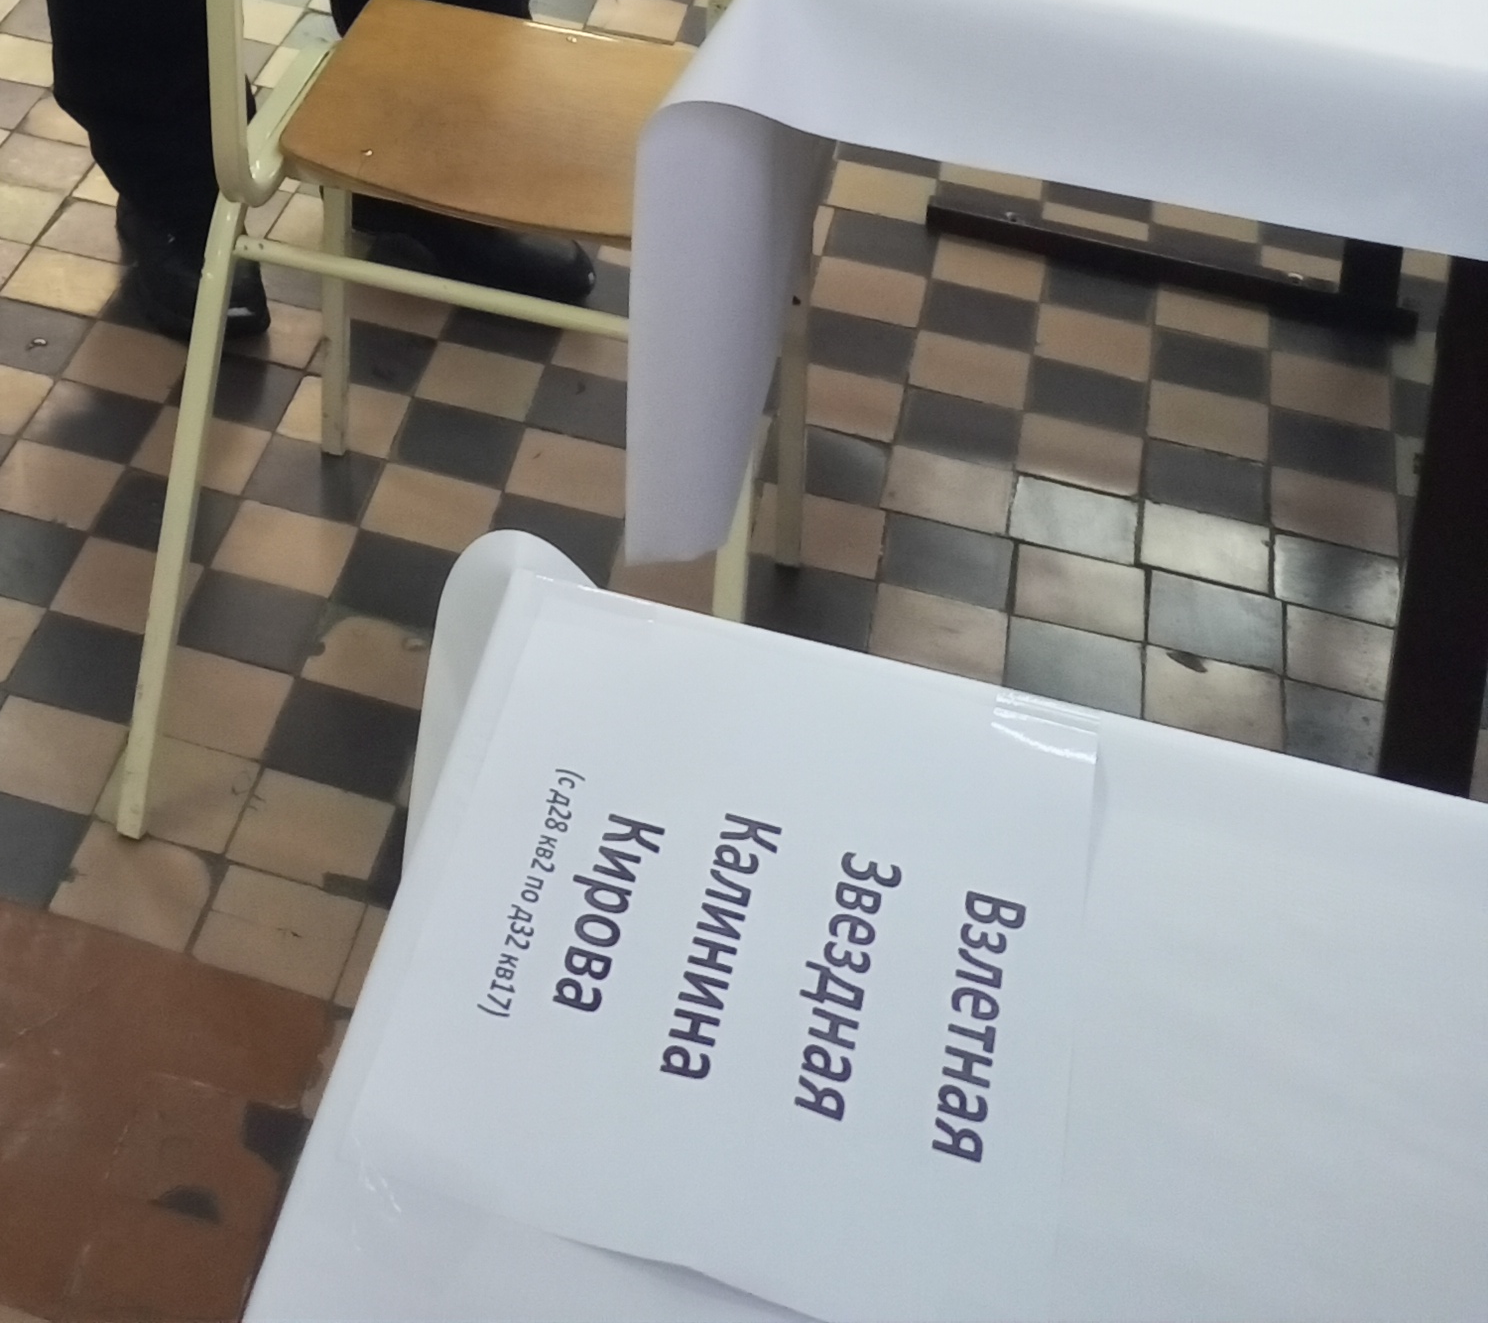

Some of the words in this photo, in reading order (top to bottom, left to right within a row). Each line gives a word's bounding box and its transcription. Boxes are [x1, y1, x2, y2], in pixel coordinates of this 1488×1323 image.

[520, 875, 545, 904] по
[530, 834, 558, 873] кв2
[552, 813, 666, 1013] Кирова
[476, 952, 520, 1018] кв17)
[504, 903, 535, 950] д32
[659, 812, 783, 1080] Калинина
[794, 851, 903, 1122] Звездная
[931, 890, 1027, 1164] Взлетная
